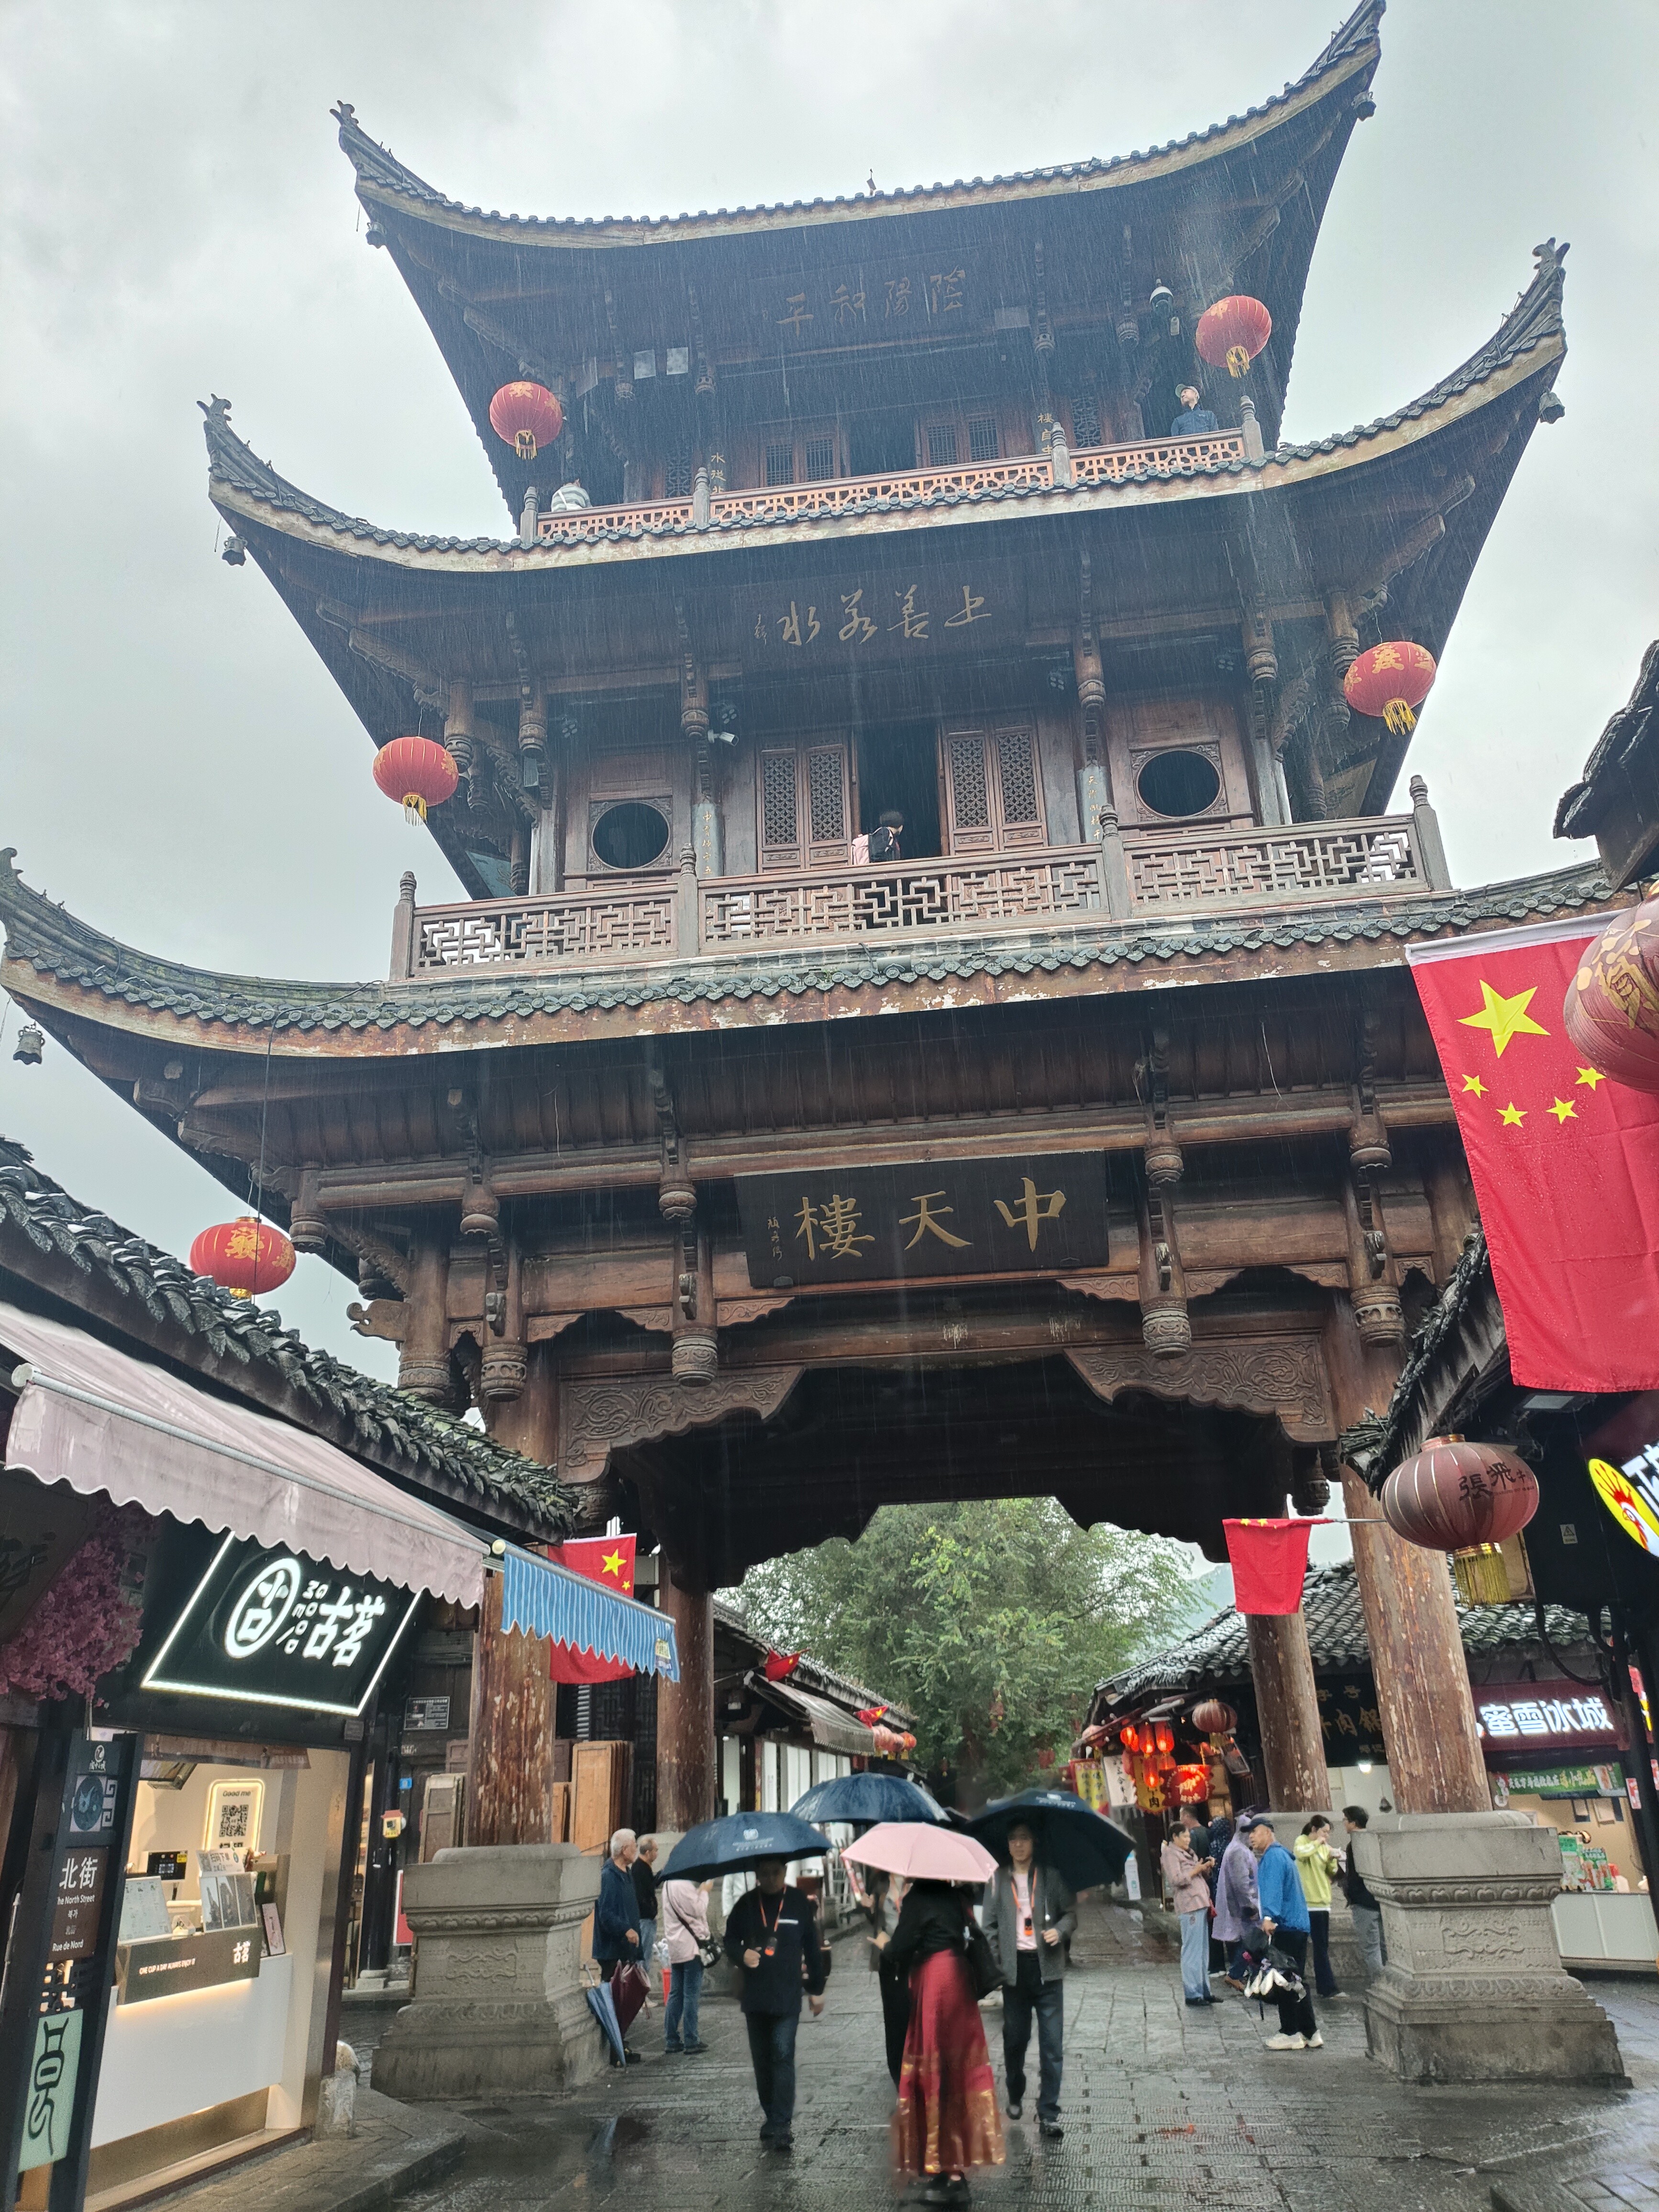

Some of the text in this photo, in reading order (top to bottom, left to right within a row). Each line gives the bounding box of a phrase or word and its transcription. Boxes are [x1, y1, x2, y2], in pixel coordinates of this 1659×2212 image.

[794, 1177, 1067, 1261] 中天樓
[302, 1585, 385, 1667] 古茗
[1480, 1696, 1615, 1737] 蜜雪冰城
[59, 1857, 98, 1890] 北街
[65, 1896, 79, 1904] North
[80, 1894, 95, 1903] Street
[52, 1939, 84, 1952] Rue de Nord
